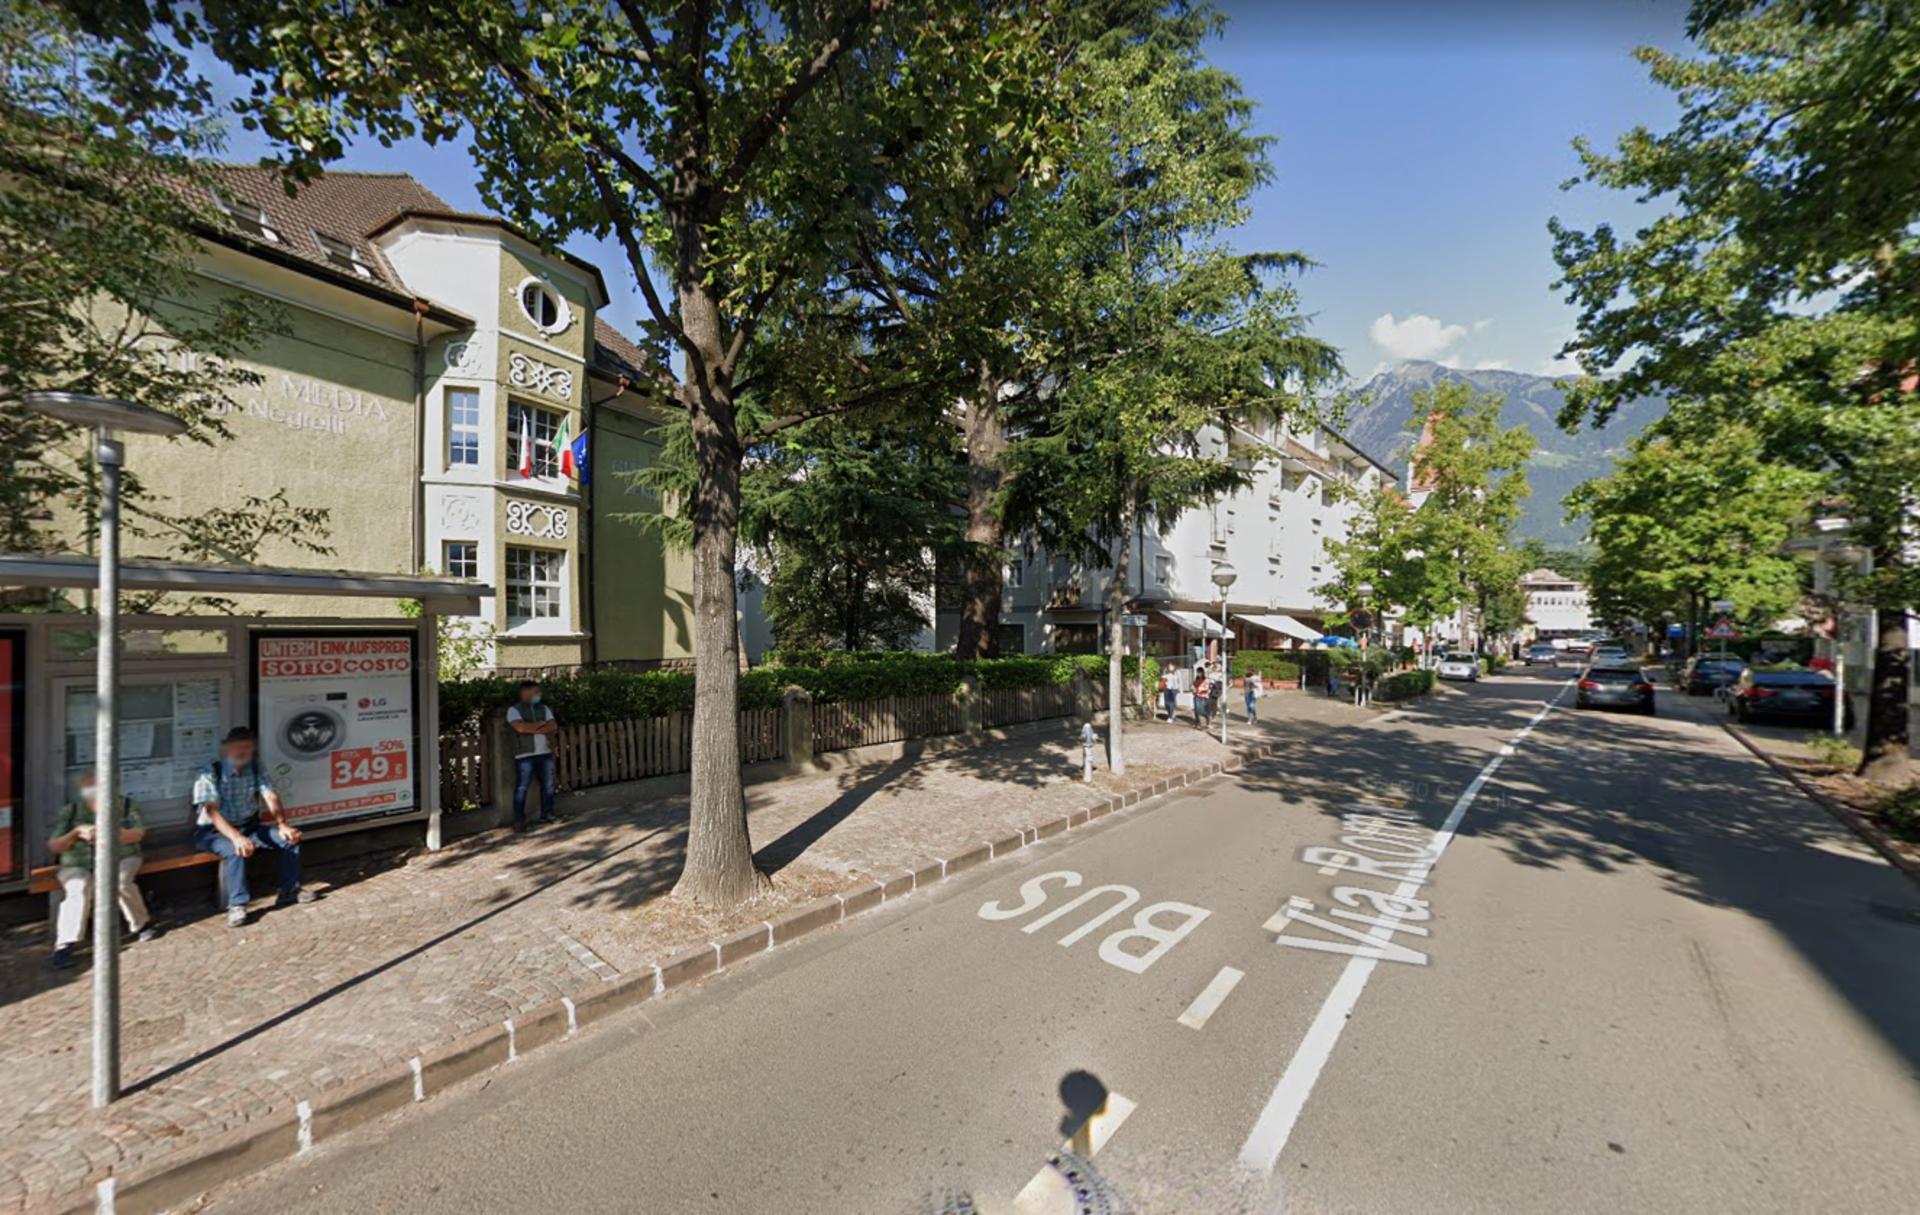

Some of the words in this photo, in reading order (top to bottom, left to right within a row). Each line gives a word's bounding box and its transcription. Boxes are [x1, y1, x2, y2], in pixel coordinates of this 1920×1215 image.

[281, 375, 388, 421] MEDIA
[248, 399, 346, 434] Negrelli
[261, 640, 317, 656] UNTERM
[321, 640, 409, 655] EINKAUFSPREIS
[266, 659, 338, 676] SOTTO
[343, 658, 409, 672] COSTO
[372, 698, 387, 707] LG
[335, 757, 389, 784] 349
[291, 794, 395, 816] INTERSPAR
[977, 870, 1212, 974] BUS
